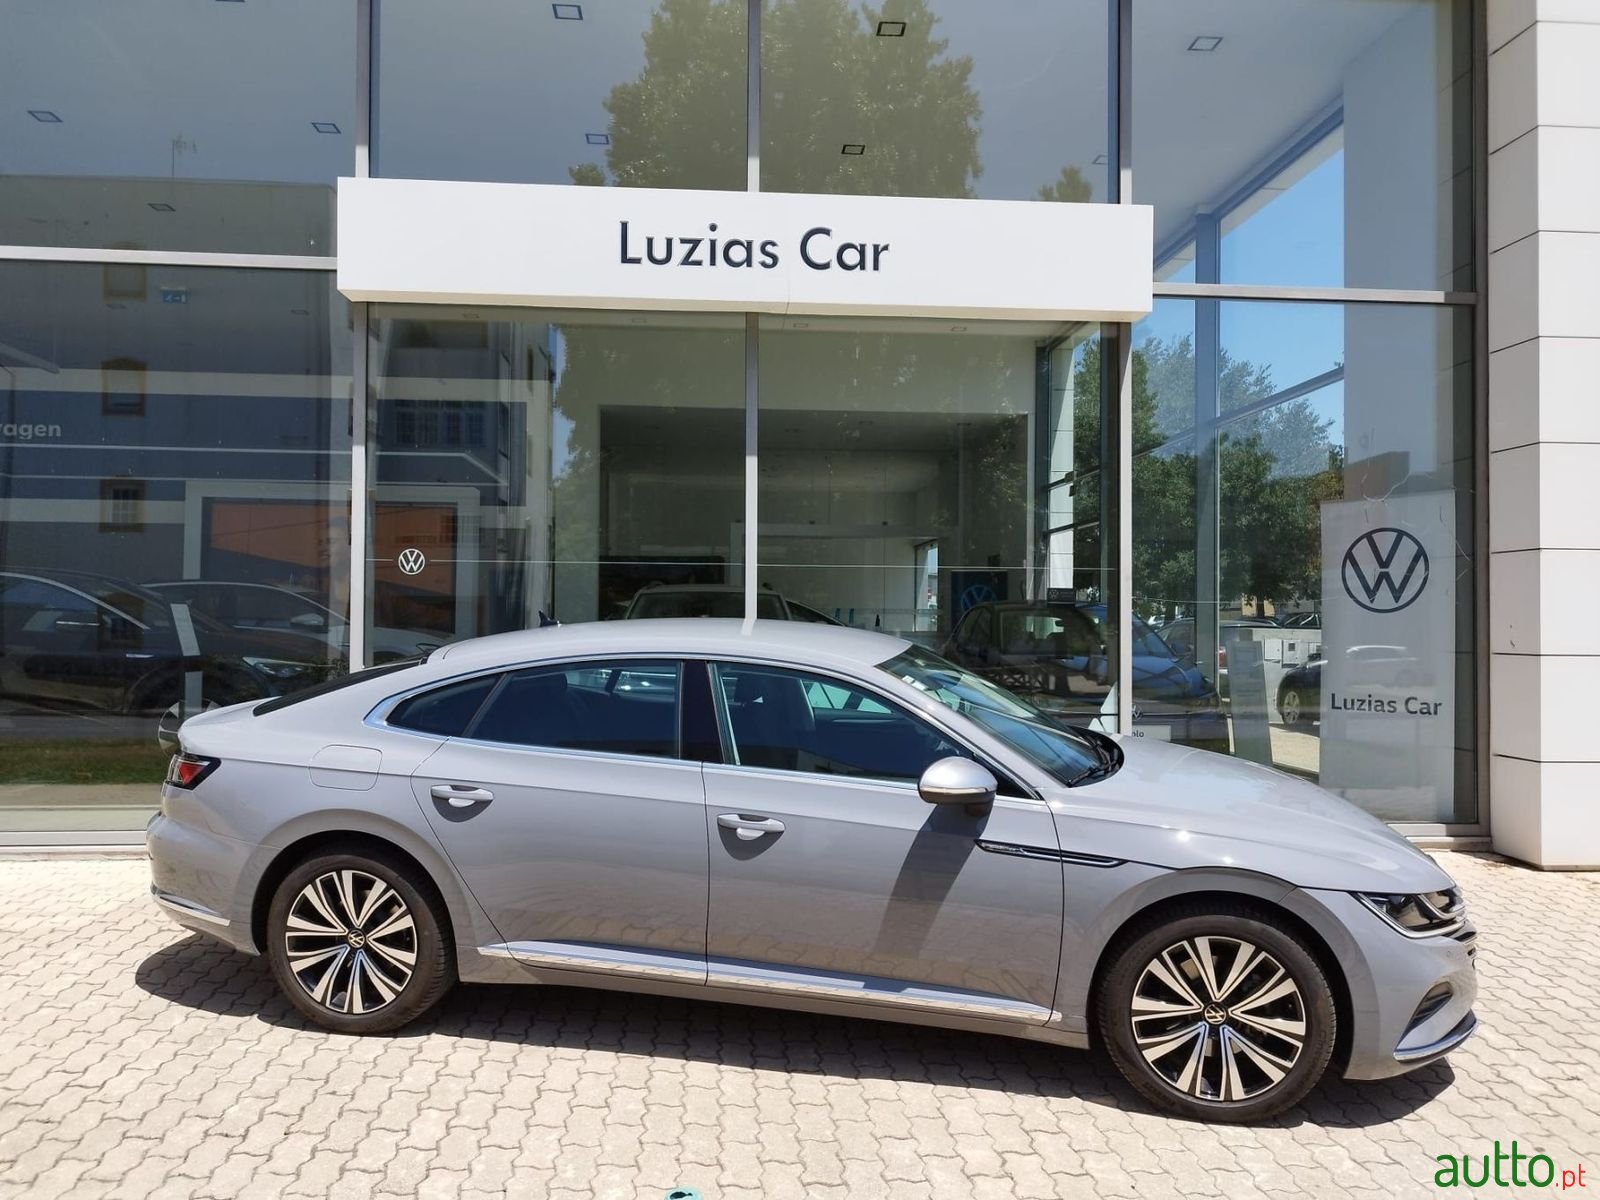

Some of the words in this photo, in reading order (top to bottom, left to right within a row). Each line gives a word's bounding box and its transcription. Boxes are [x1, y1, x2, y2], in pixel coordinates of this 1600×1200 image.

[619, 220, 780, 270] Luzias
[799, 226, 890, 272] Car
[0, 423, 62, 441] agen
[1330, 692, 1398, 714] Luzias
[1404, 696, 1443, 716] Car
